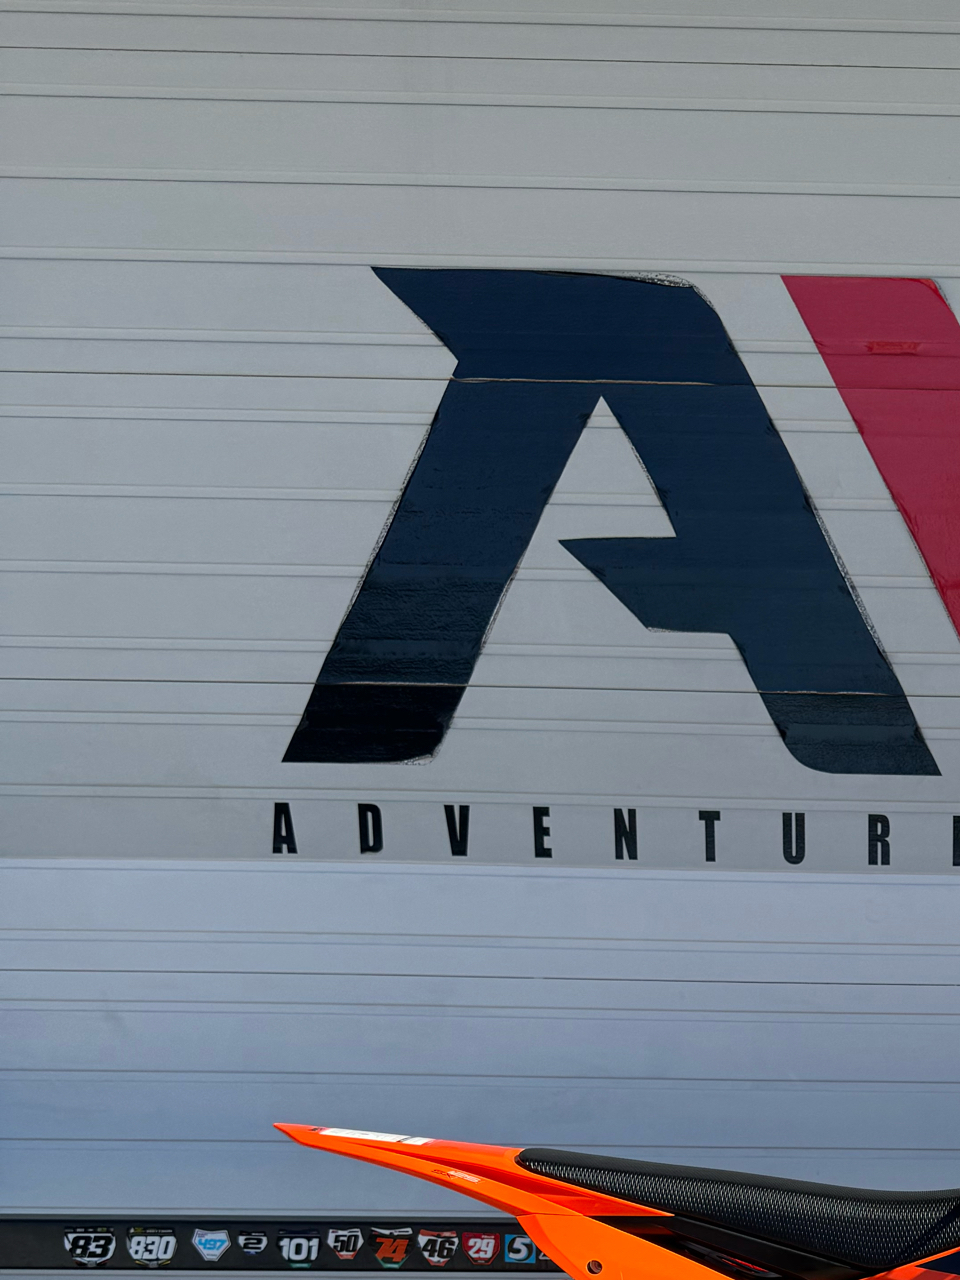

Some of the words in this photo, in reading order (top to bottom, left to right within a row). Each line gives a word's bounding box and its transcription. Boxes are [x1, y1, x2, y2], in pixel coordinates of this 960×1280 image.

[70, 1235, 114, 1259] 83
[129, 1235, 177, 1260] 830
[198, 1239, 228, 1251] 497
[242, 1237, 264, 1250] 2
[279, 1237, 320, 1261] 101
[333, 1234, 360, 1253] 50
[375, 1237, 409, 1262] 74
[422, 1239, 456, 1259] 46
[468, 1238, 496, 1259] 29
